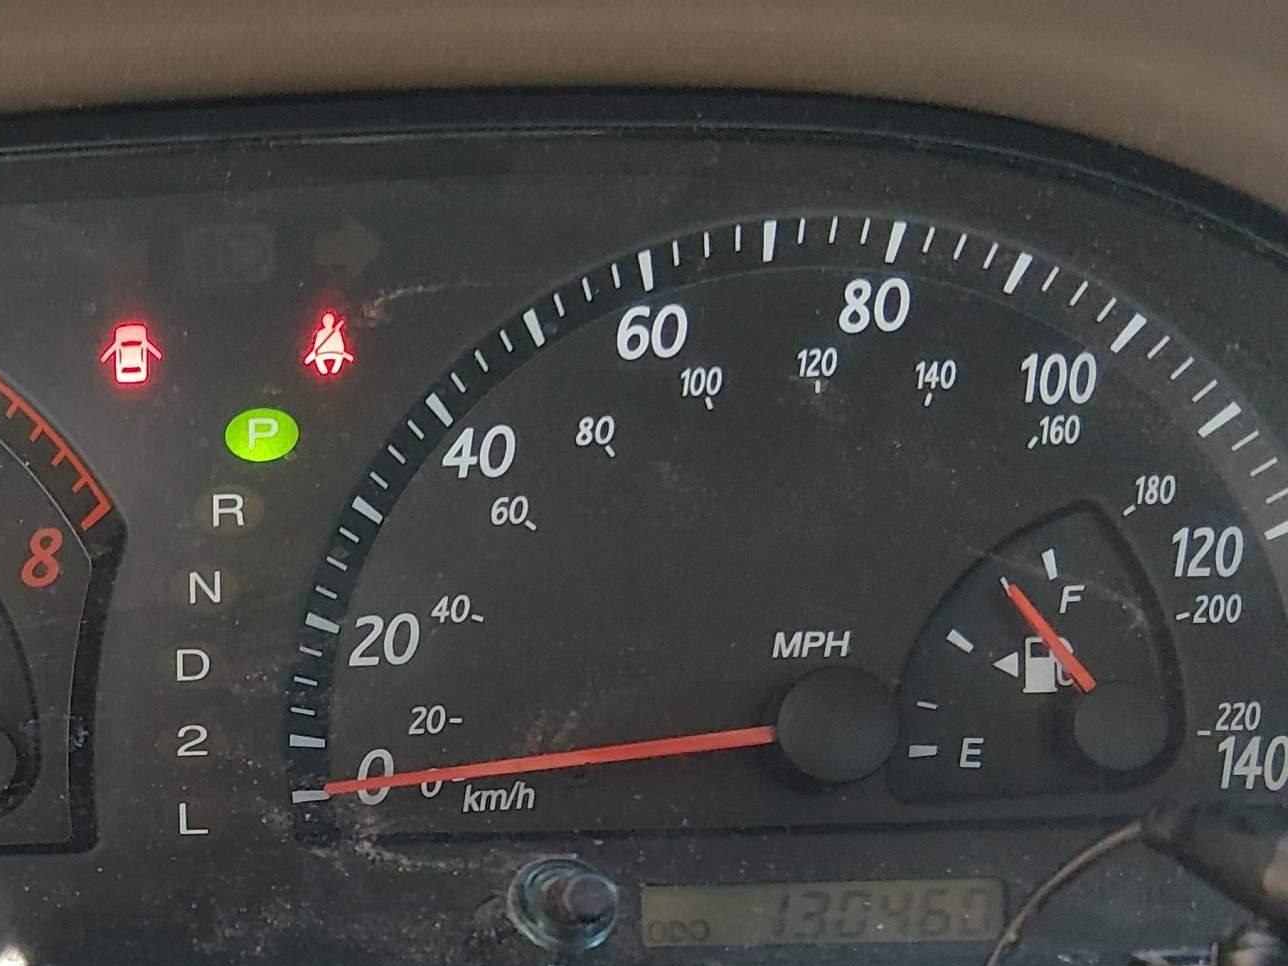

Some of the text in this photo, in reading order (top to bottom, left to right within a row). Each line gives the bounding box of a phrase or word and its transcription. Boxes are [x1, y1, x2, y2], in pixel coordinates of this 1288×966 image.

[839, 278, 910, 333] 80
[616, 305, 688, 360] 60
[797, 348, 837, 377] 120
[916, 360, 956, 390] 140
[1020, 352, 1097, 404] 100
[680, 367, 722, 398] 100
[247, 418, 279, 449] P
[576, 416, 614, 446] 80
[1040, 415, 1080, 446] 160
[442, 425, 516, 478] 40
[1135, 475, 1175, 504] 180
[213, 494, 245, 526] R
[491, 496, 528, 526] 60
[20, 527, 62, 588] 8
[1171, 526, 1244, 577] 120
[190, 571, 221, 603] N
[1060, 585, 1085, 613] F
[431, 594, 470, 624] 40
[1192, 594, 1242, 623] 200
[349, 612, 420, 666] 20
[772, 631, 850, 658] MPH
[176, 649, 209, 681] D
[408, 705, 445, 735] 20
[1215, 701, 1261, 731] 220
[177, 724, 208, 756] 2
[959, 738, 983, 768] E
[357, 749, 395, 805] 0
[1218, 735, 1288, 791] 140
[462, 781, 535, 812] km/h
[179, 803, 209, 835] L
